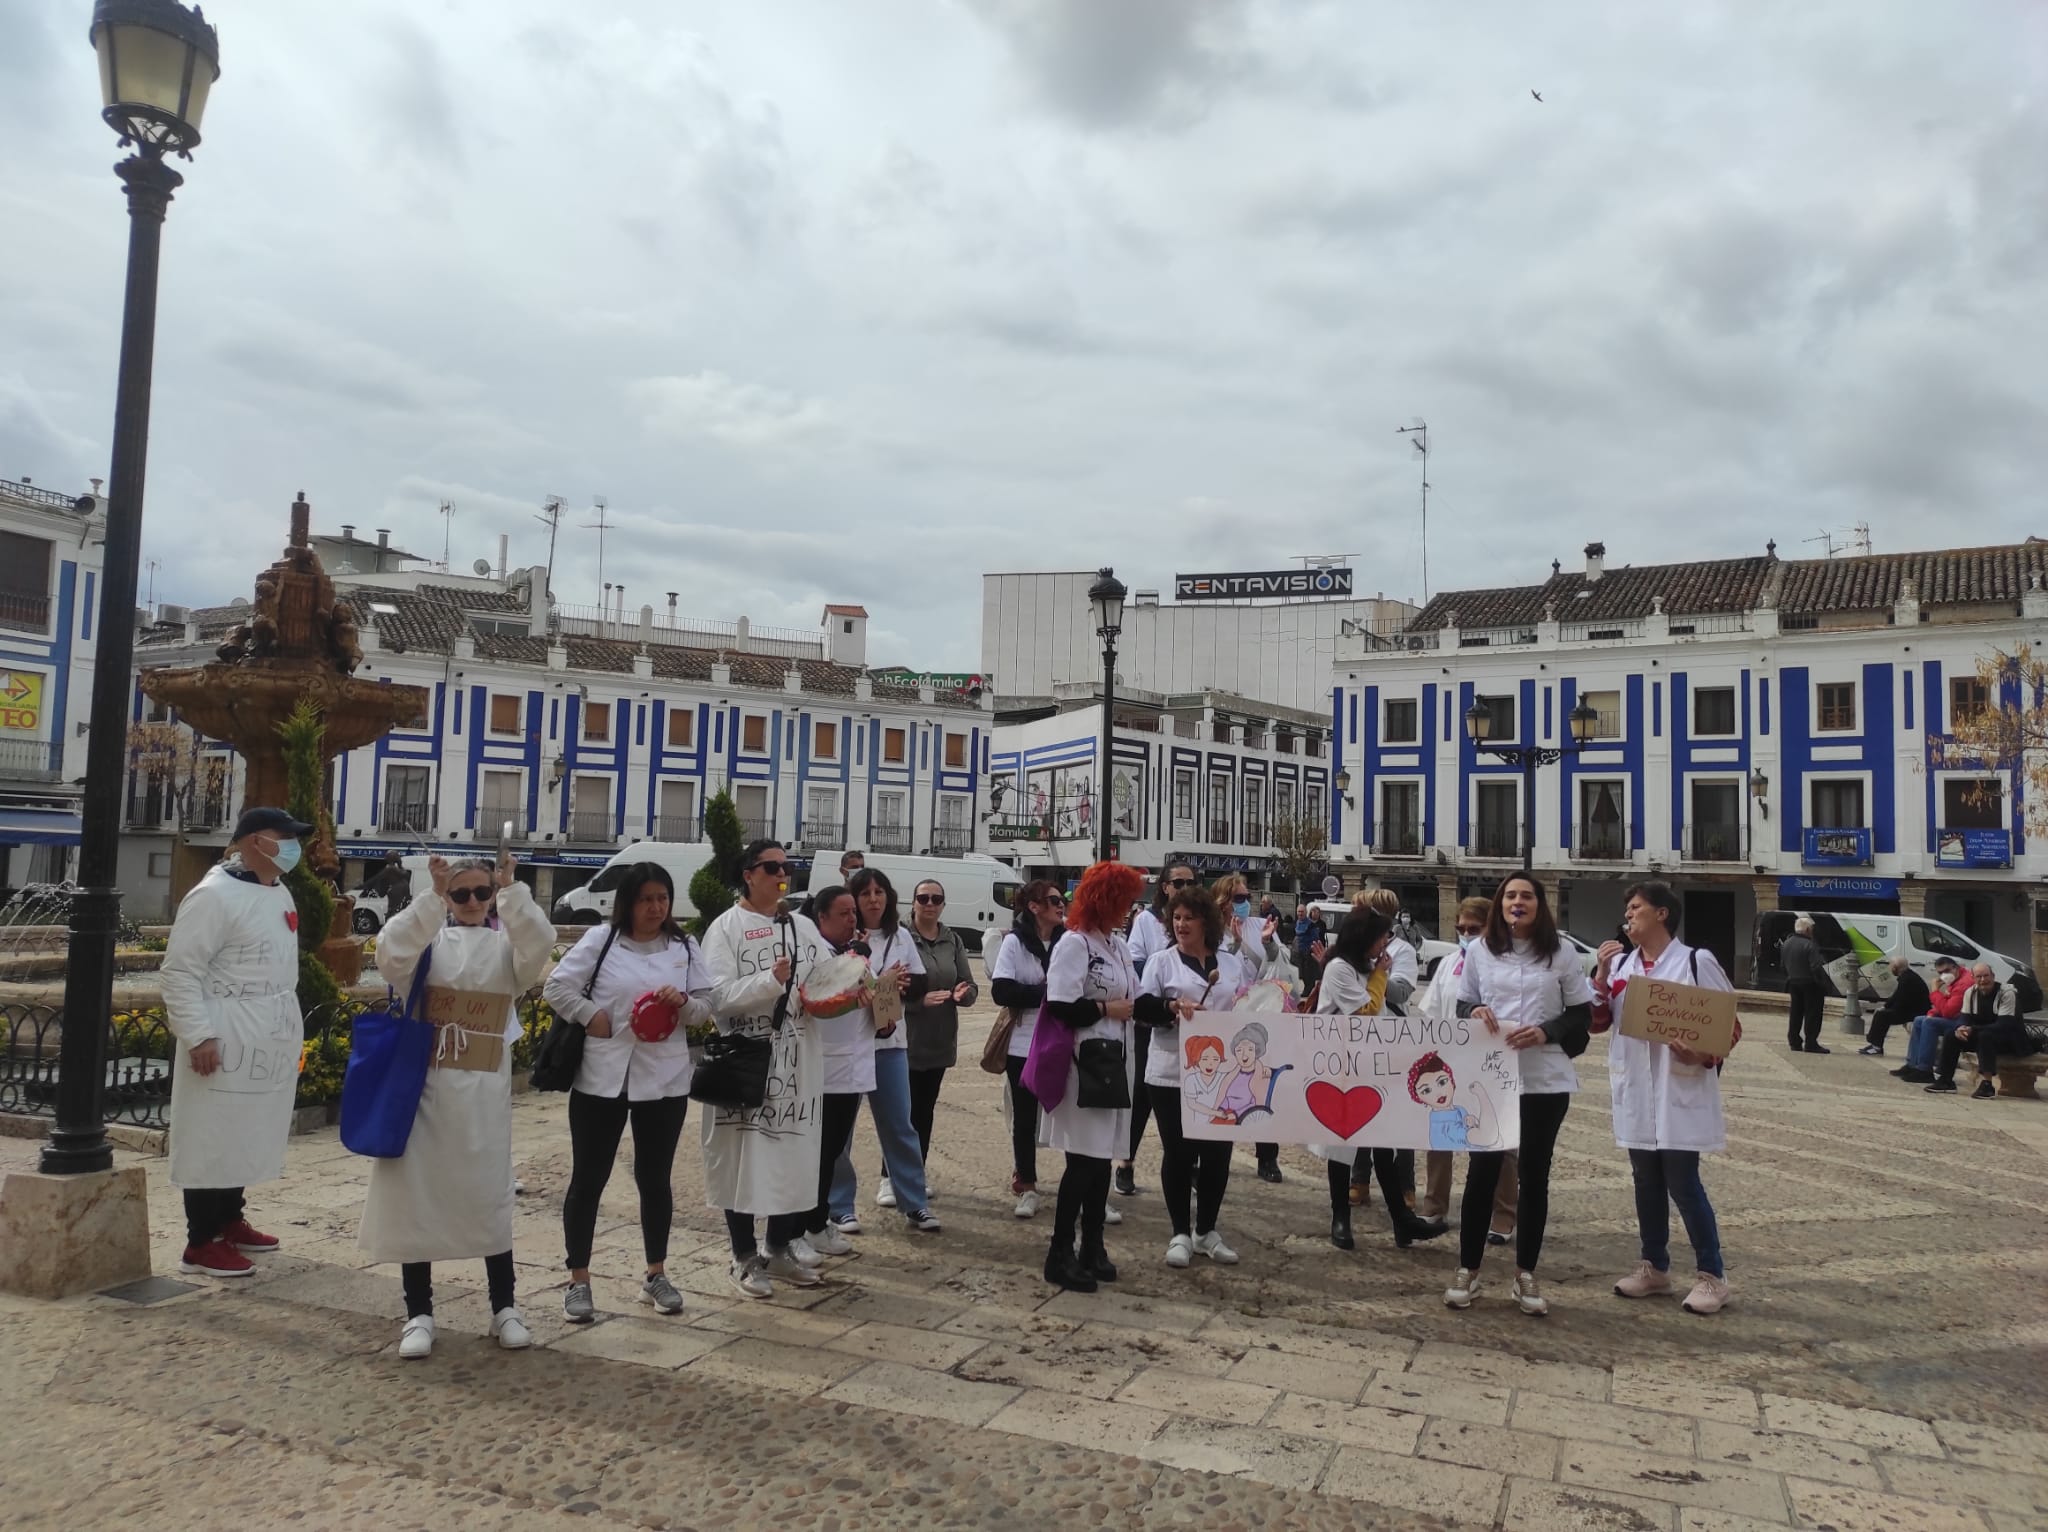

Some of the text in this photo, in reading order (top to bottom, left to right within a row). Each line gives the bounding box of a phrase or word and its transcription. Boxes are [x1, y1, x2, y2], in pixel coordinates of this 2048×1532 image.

[1176, 573, 1351, 595] RENTAVISION
[1795, 878, 1882, 890] San Antonio
[466, 1000, 489, 1016] UN
[1690, 997, 1710, 1007] UN
[1295, 1016, 1470, 1046] TRABAJAMOS
[1646, 1021, 1700, 1041] JUSTO
[1312, 1051, 1401, 1077] CON EL
[1486, 1050, 1503, 1062] WE
[1481, 1060, 1505, 1072] CAN
